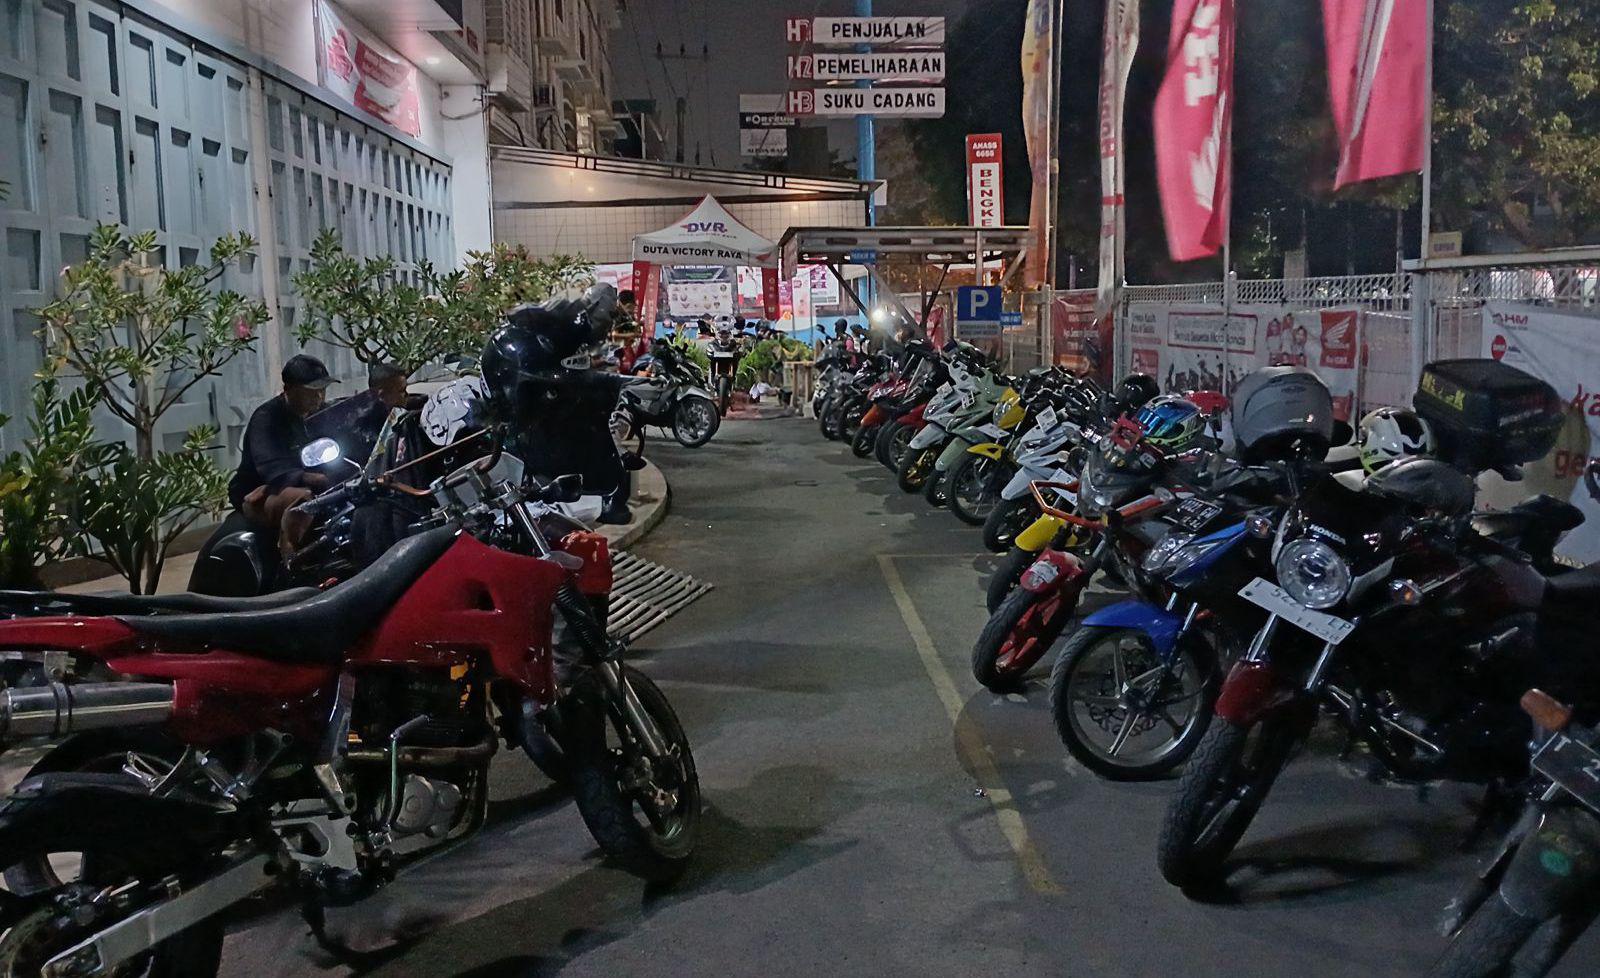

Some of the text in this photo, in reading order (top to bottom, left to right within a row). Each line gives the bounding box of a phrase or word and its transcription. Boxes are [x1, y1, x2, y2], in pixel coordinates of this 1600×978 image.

[831, 22, 925, 39] PENJUALAN
[817, 58, 941, 74] PEMELIHARAAN
[789, 90, 936, 113] H3 SUKU CADANG
[687, 222, 728, 233] DVR
[643, 245, 742, 260] DUTA VICTORY RAYA
[970, 289, 989, 318] P
[1309, 524, 1346, 545] HONDA
